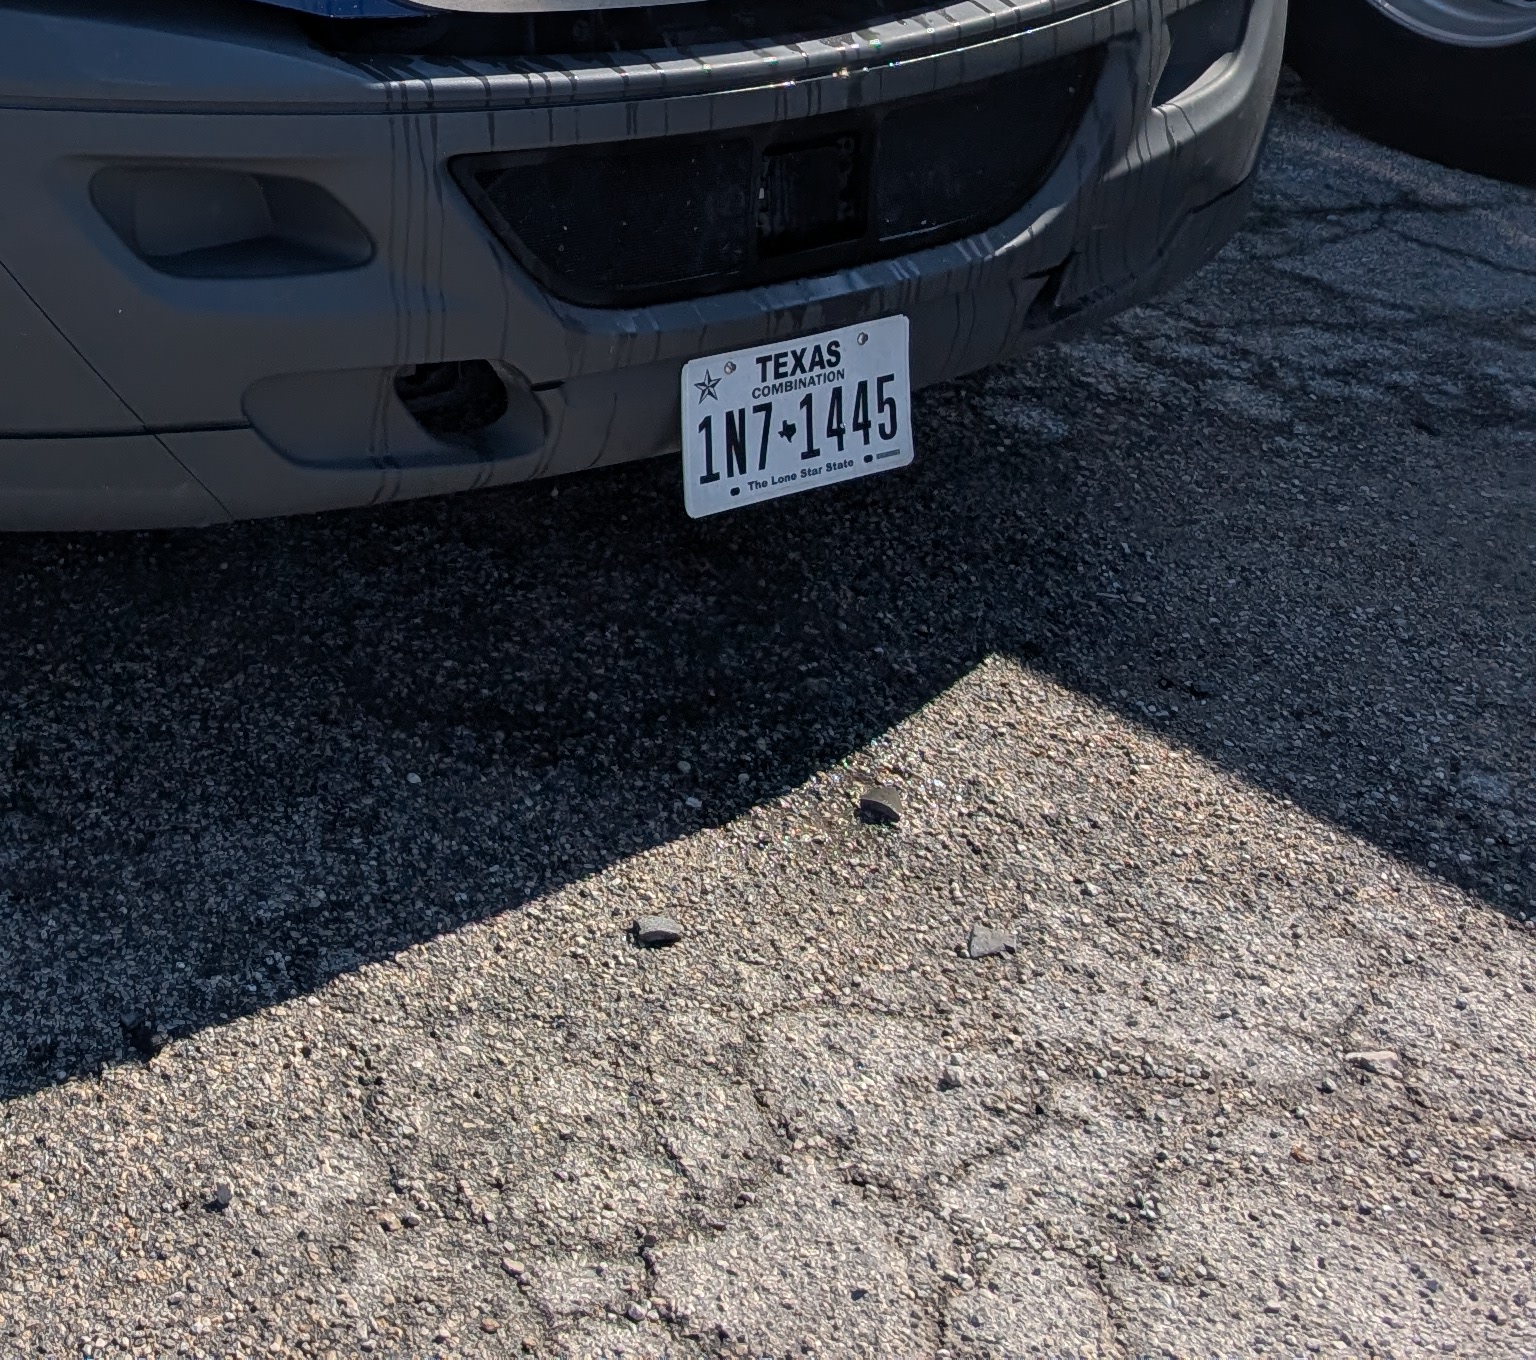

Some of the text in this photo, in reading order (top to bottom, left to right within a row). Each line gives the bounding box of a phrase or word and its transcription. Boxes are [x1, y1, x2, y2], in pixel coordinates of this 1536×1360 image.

[756, 340, 841, 383] TEXAS
[752, 368, 844, 399] COMBINATION
[698, 374, 897, 485] 1N7 1445
[747, 459, 854, 491] The Lone Star State
